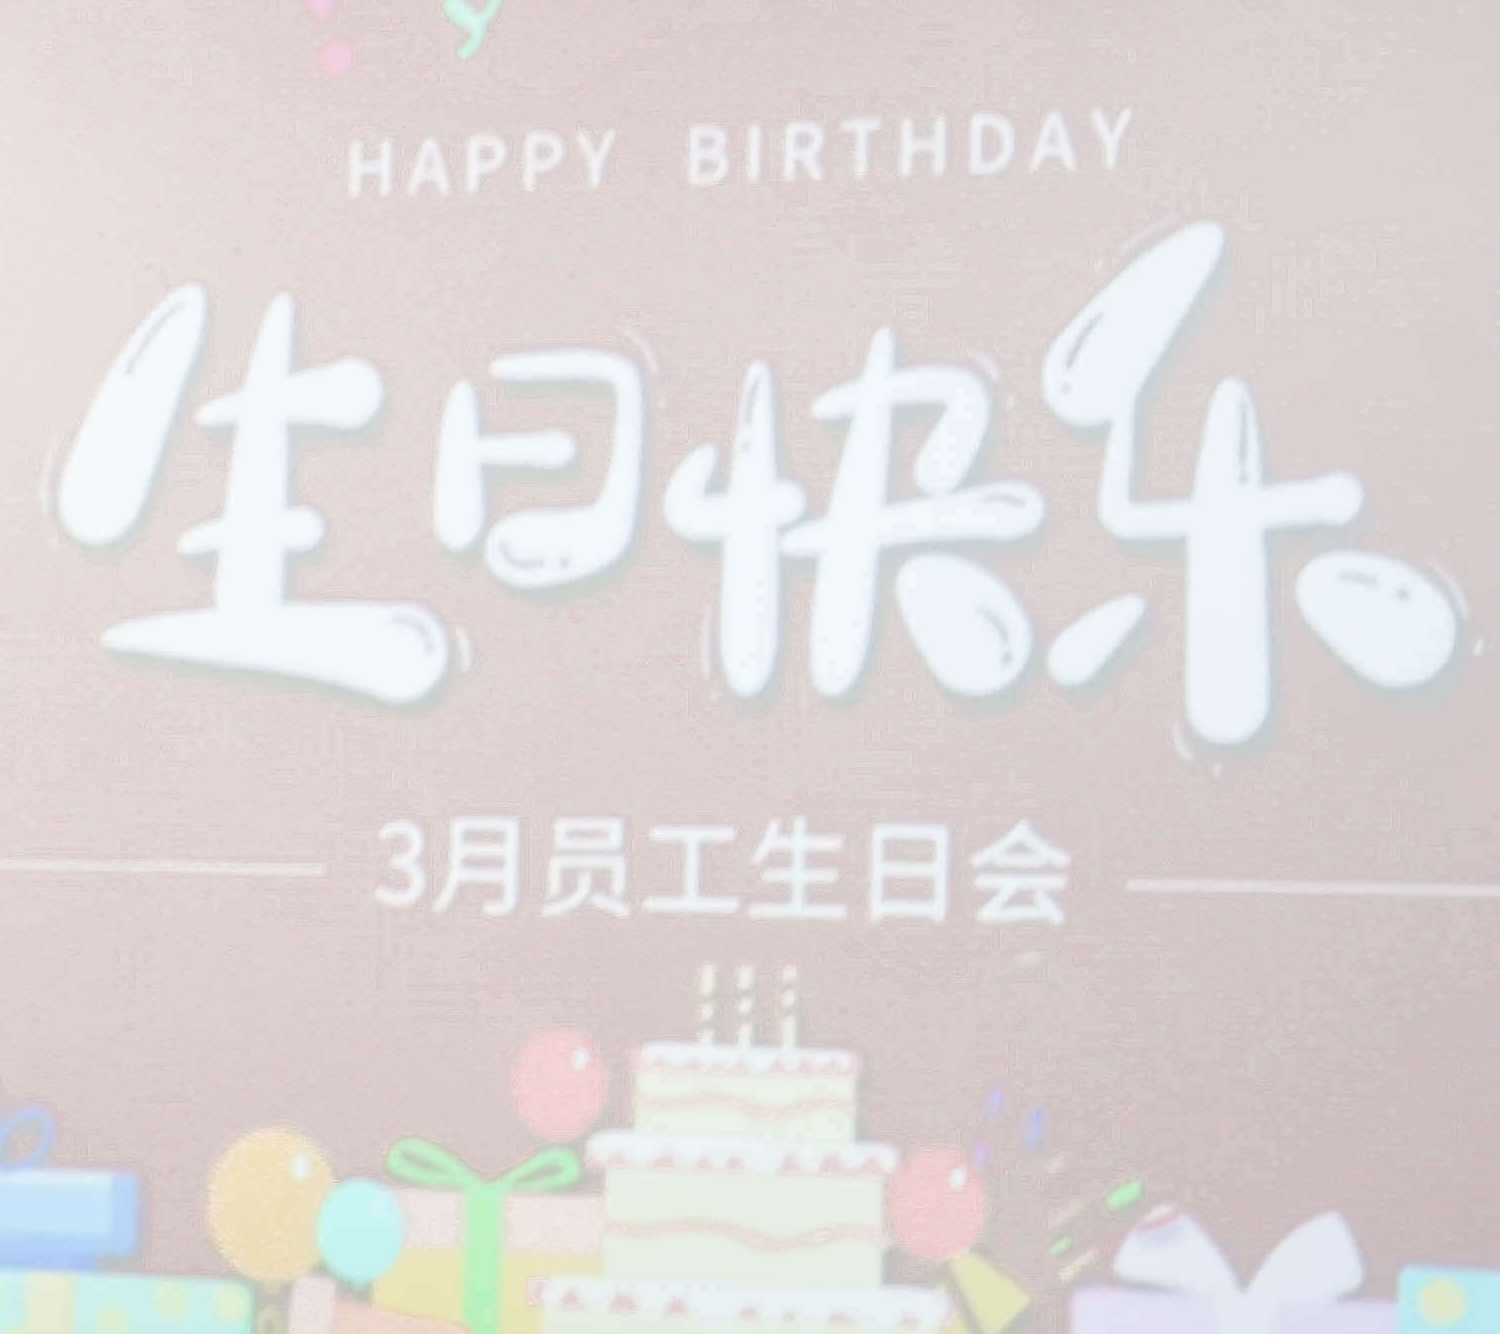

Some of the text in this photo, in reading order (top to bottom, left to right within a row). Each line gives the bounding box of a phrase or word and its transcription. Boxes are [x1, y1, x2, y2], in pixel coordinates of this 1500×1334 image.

[348, 107, 1135, 197] HAPPY BIRTHDAY
[53, 220, 1461, 745] 生日快乐
[372, 816, 1073, 926] 3月员工生日会
